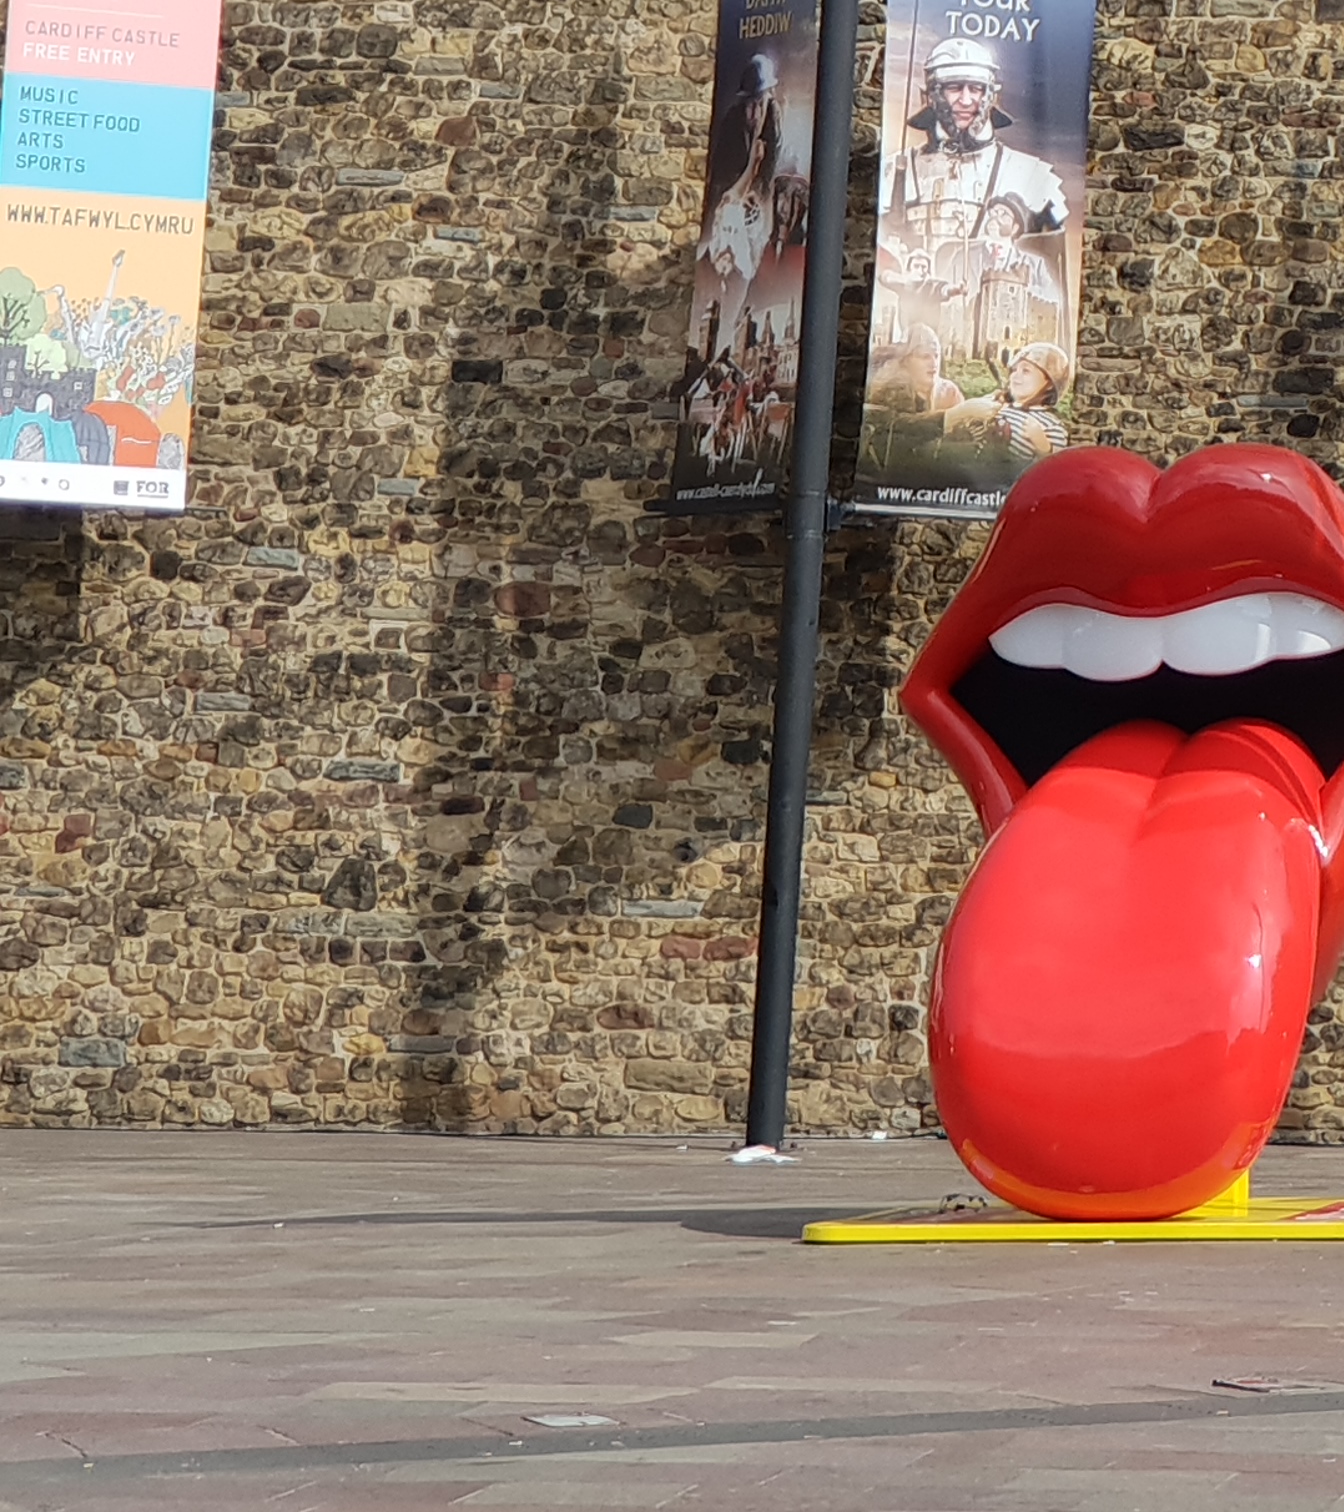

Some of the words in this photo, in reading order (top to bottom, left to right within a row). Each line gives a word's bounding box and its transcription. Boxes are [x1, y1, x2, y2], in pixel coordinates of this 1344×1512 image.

[25, 20, 107, 40] CARDIFF
[112, 28, 180, 47] CASTLE
[739, 11, 793, 39] HEDDIW
[945, 11, 1040, 41] TODAY
[23, 42, 70, 61] FREE
[77, 47, 135, 66] ENTRY
[20, 86, 79, 105] MUSIC
[19, 108, 90, 128] STREET
[93, 115, 140, 132] FOOD
[17, 132, 64, 149] ARTS
[16, 154, 86, 173] SPORTS
[7, 204, 194, 235] WWW.TAFWYL.CYMRU
